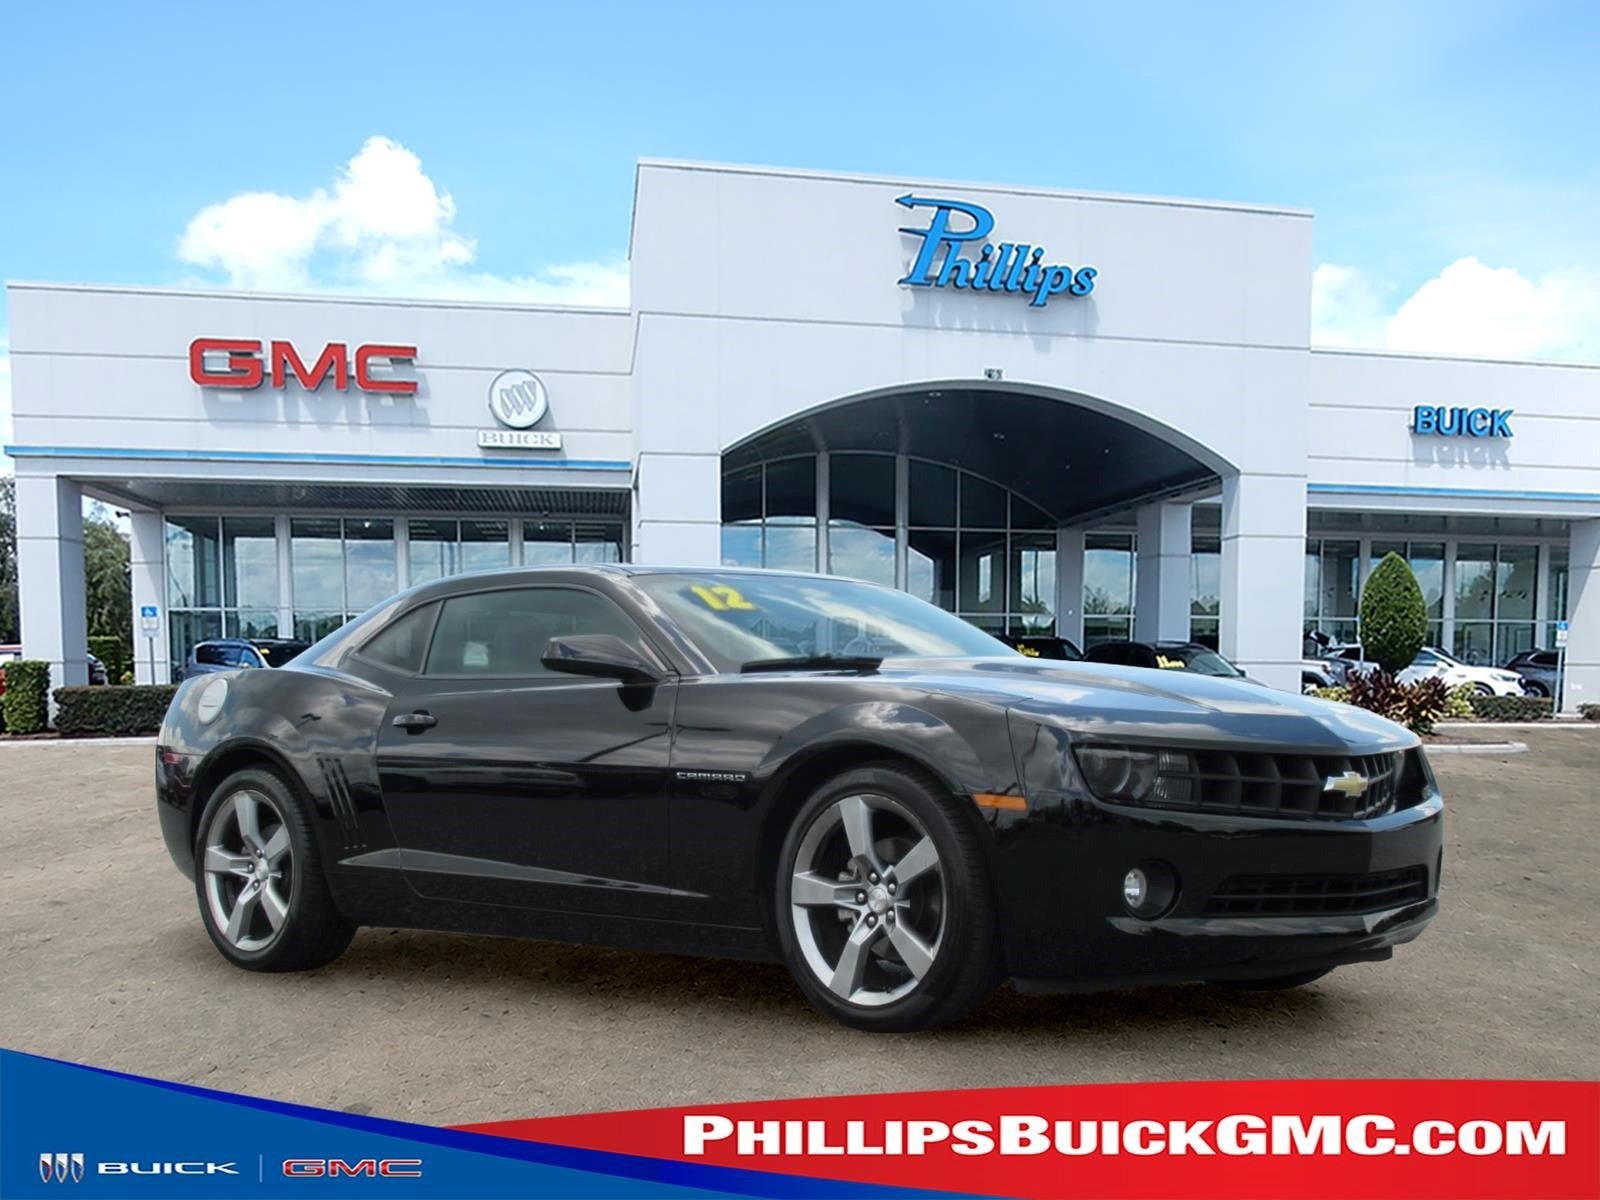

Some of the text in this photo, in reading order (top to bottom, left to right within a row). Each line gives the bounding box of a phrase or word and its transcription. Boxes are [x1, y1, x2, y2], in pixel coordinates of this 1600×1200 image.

[895, 193, 1098, 307] Phillips
[189, 338, 418, 394] GMC
[1414, 404, 1514, 438] BUICK
[482, 432, 554, 445] BUICK
[689, 586, 756, 611] 12
